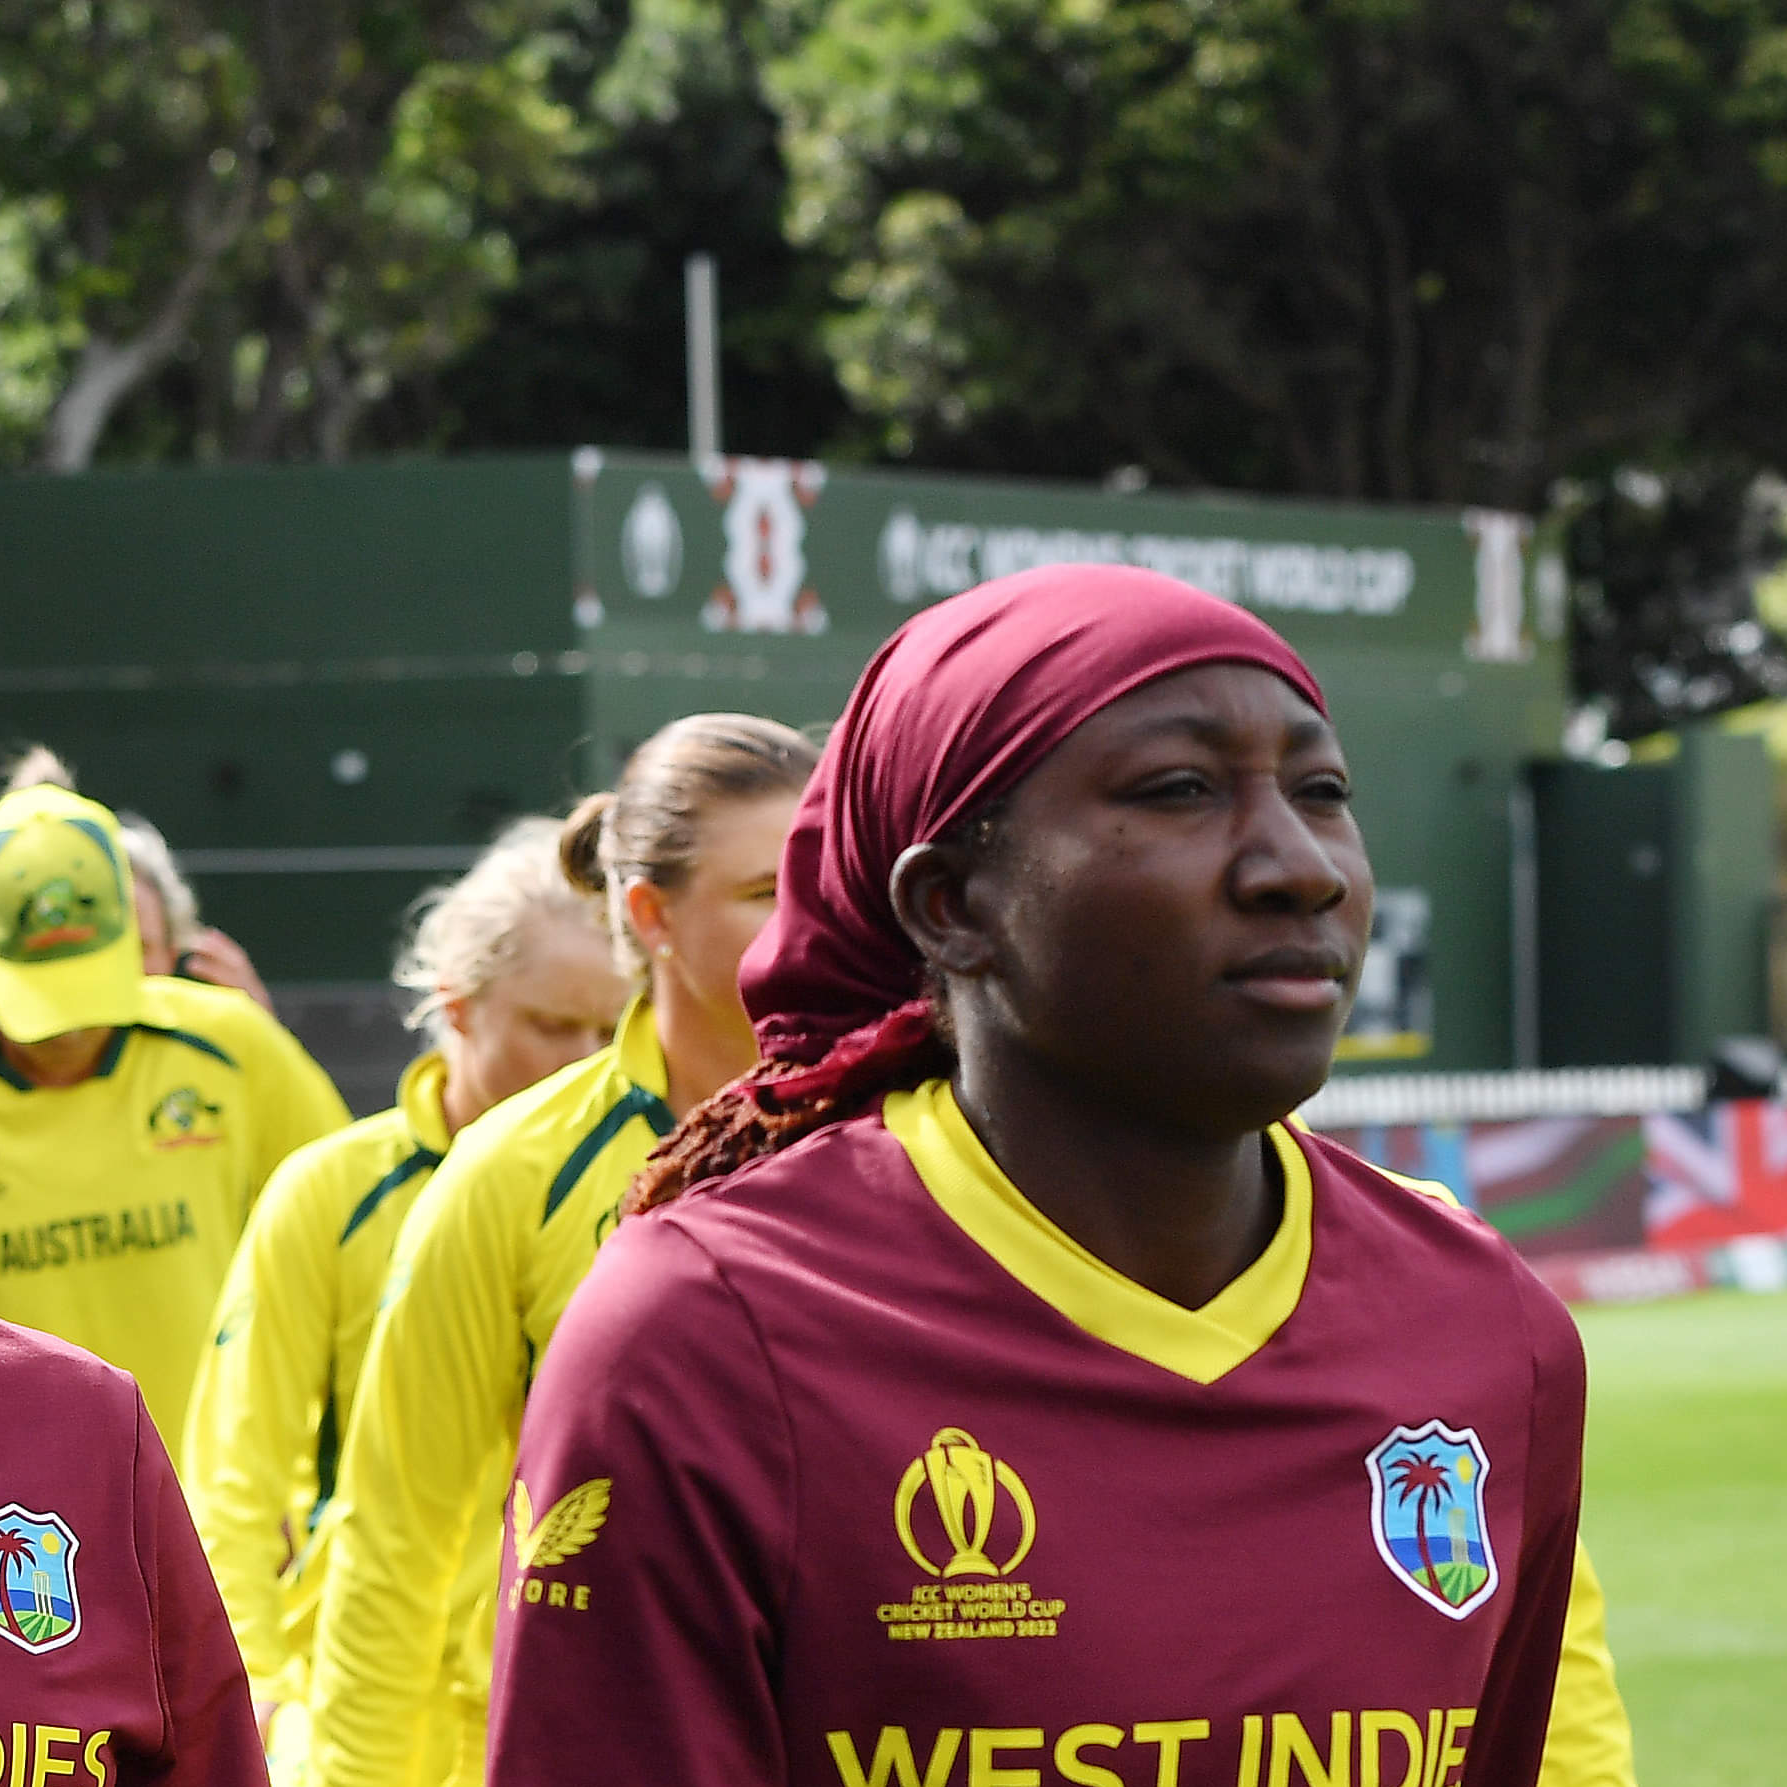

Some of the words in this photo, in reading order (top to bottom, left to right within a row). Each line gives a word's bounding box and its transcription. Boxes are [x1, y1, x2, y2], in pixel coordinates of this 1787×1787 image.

[913, 1584, 942, 1602] ICC
[877, 1602, 956, 1622] CRICKET
[958, 1600, 1027, 1619] WORLD
[1028, 1599, 1066, 1617] CUP
[888, 1623, 931, 1640] NEW
[933, 1620, 1015, 1639] ZEALAND
